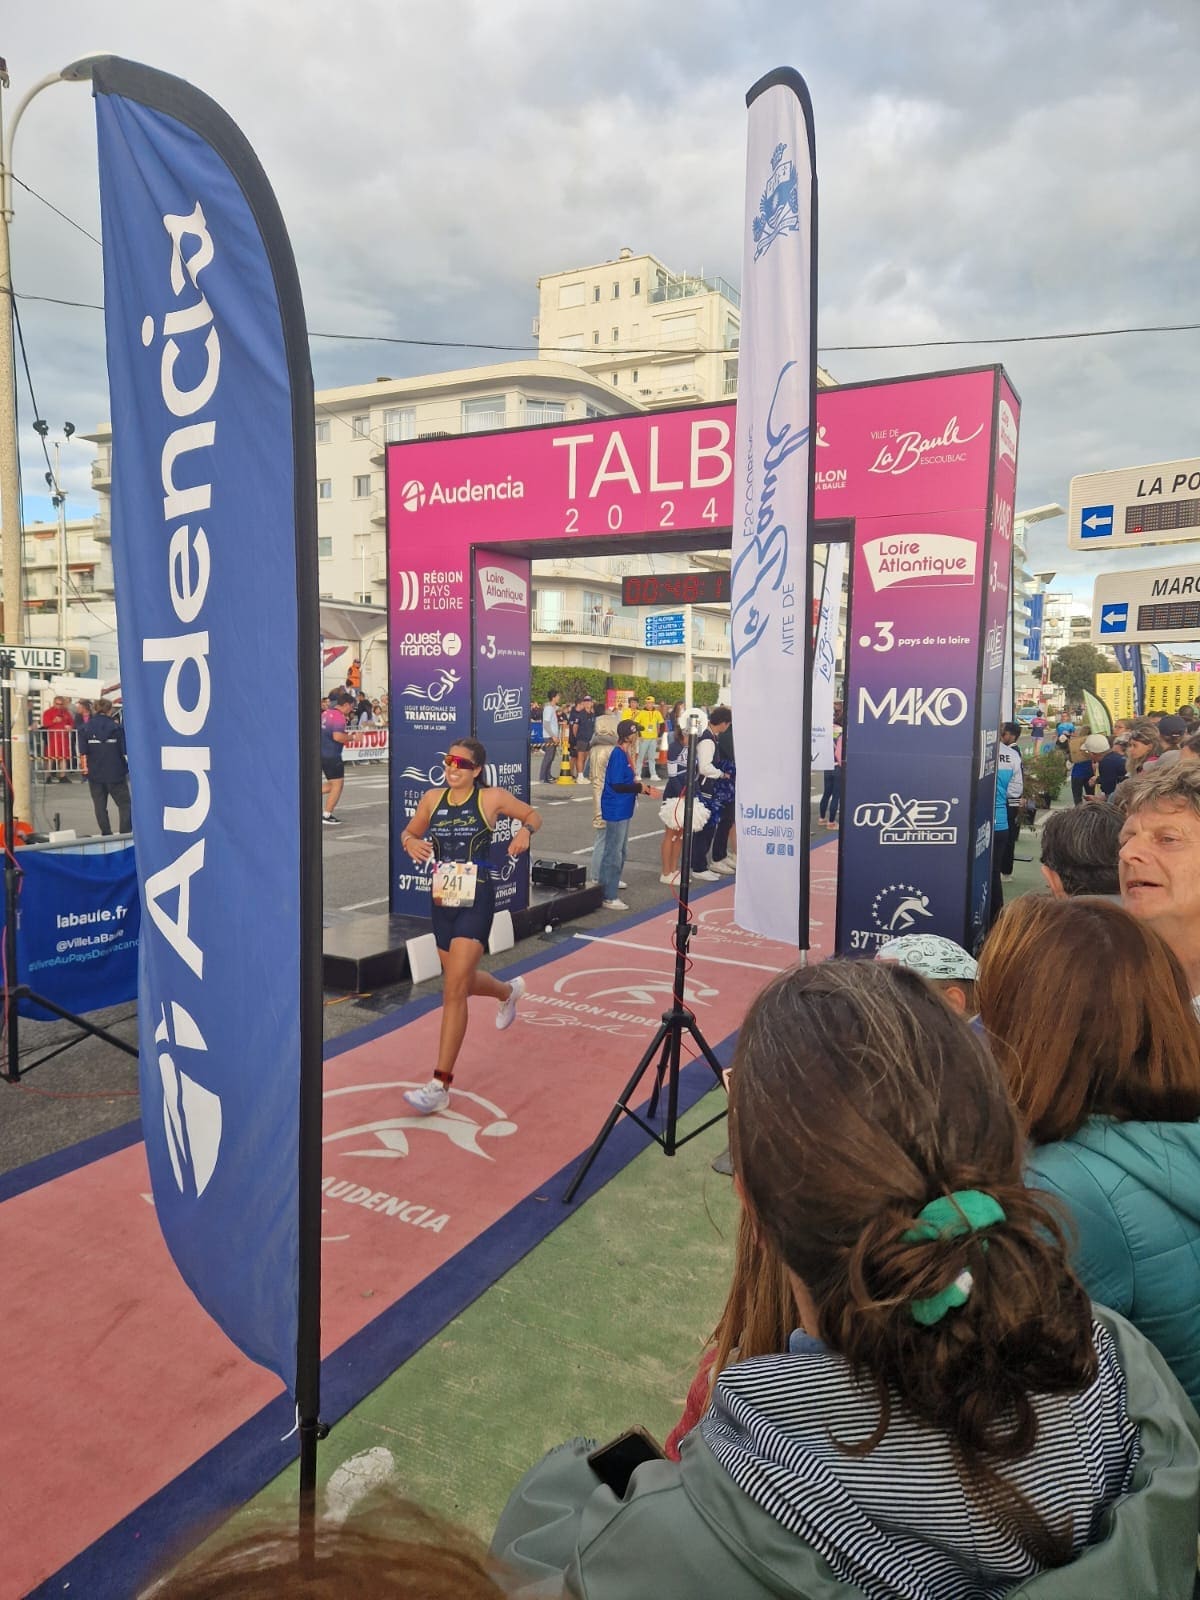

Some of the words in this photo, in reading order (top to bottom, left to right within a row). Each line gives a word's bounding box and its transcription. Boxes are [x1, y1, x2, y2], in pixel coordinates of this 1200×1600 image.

[892, 416, 984, 474] Baule
[552, 419, 732, 499] TALB
[429, 475, 524, 505] Audencia
[1137, 476, 1162, 497] LA
[879, 540, 920, 556] Loire
[878, 556, 967, 574] Atlantique
[423, 570, 463, 584] RÉGION
[486, 571, 505, 585] Loire
[142, 200, 221, 980] Audencia
[423, 585, 450, 597] PAYS
[486, 585, 523, 602] Atlantique
[433, 597, 463, 610] LOIRE
[405, 630, 441, 645] ouest
[898, 637, 920, 647] pays
[922, 636, 935, 645] de
[937, 636, 946, 645] la
[948, 635, 970, 644] loire
[400, 641, 441, 656] france
[21, 650, 61, 667] VILLE
[858, 687, 967, 726] MAKO
[405, 711, 456, 721] TRIATHLON
[499, 763, 522, 774] RÉGION
[884, 830, 953, 841] nutrition
[443, 875, 463, 891] 241
[496, 887, 516, 898] ATHLON
[56, 905, 128, 928] labaule.fr
[520, 991, 604, 1016] RIATHLON
